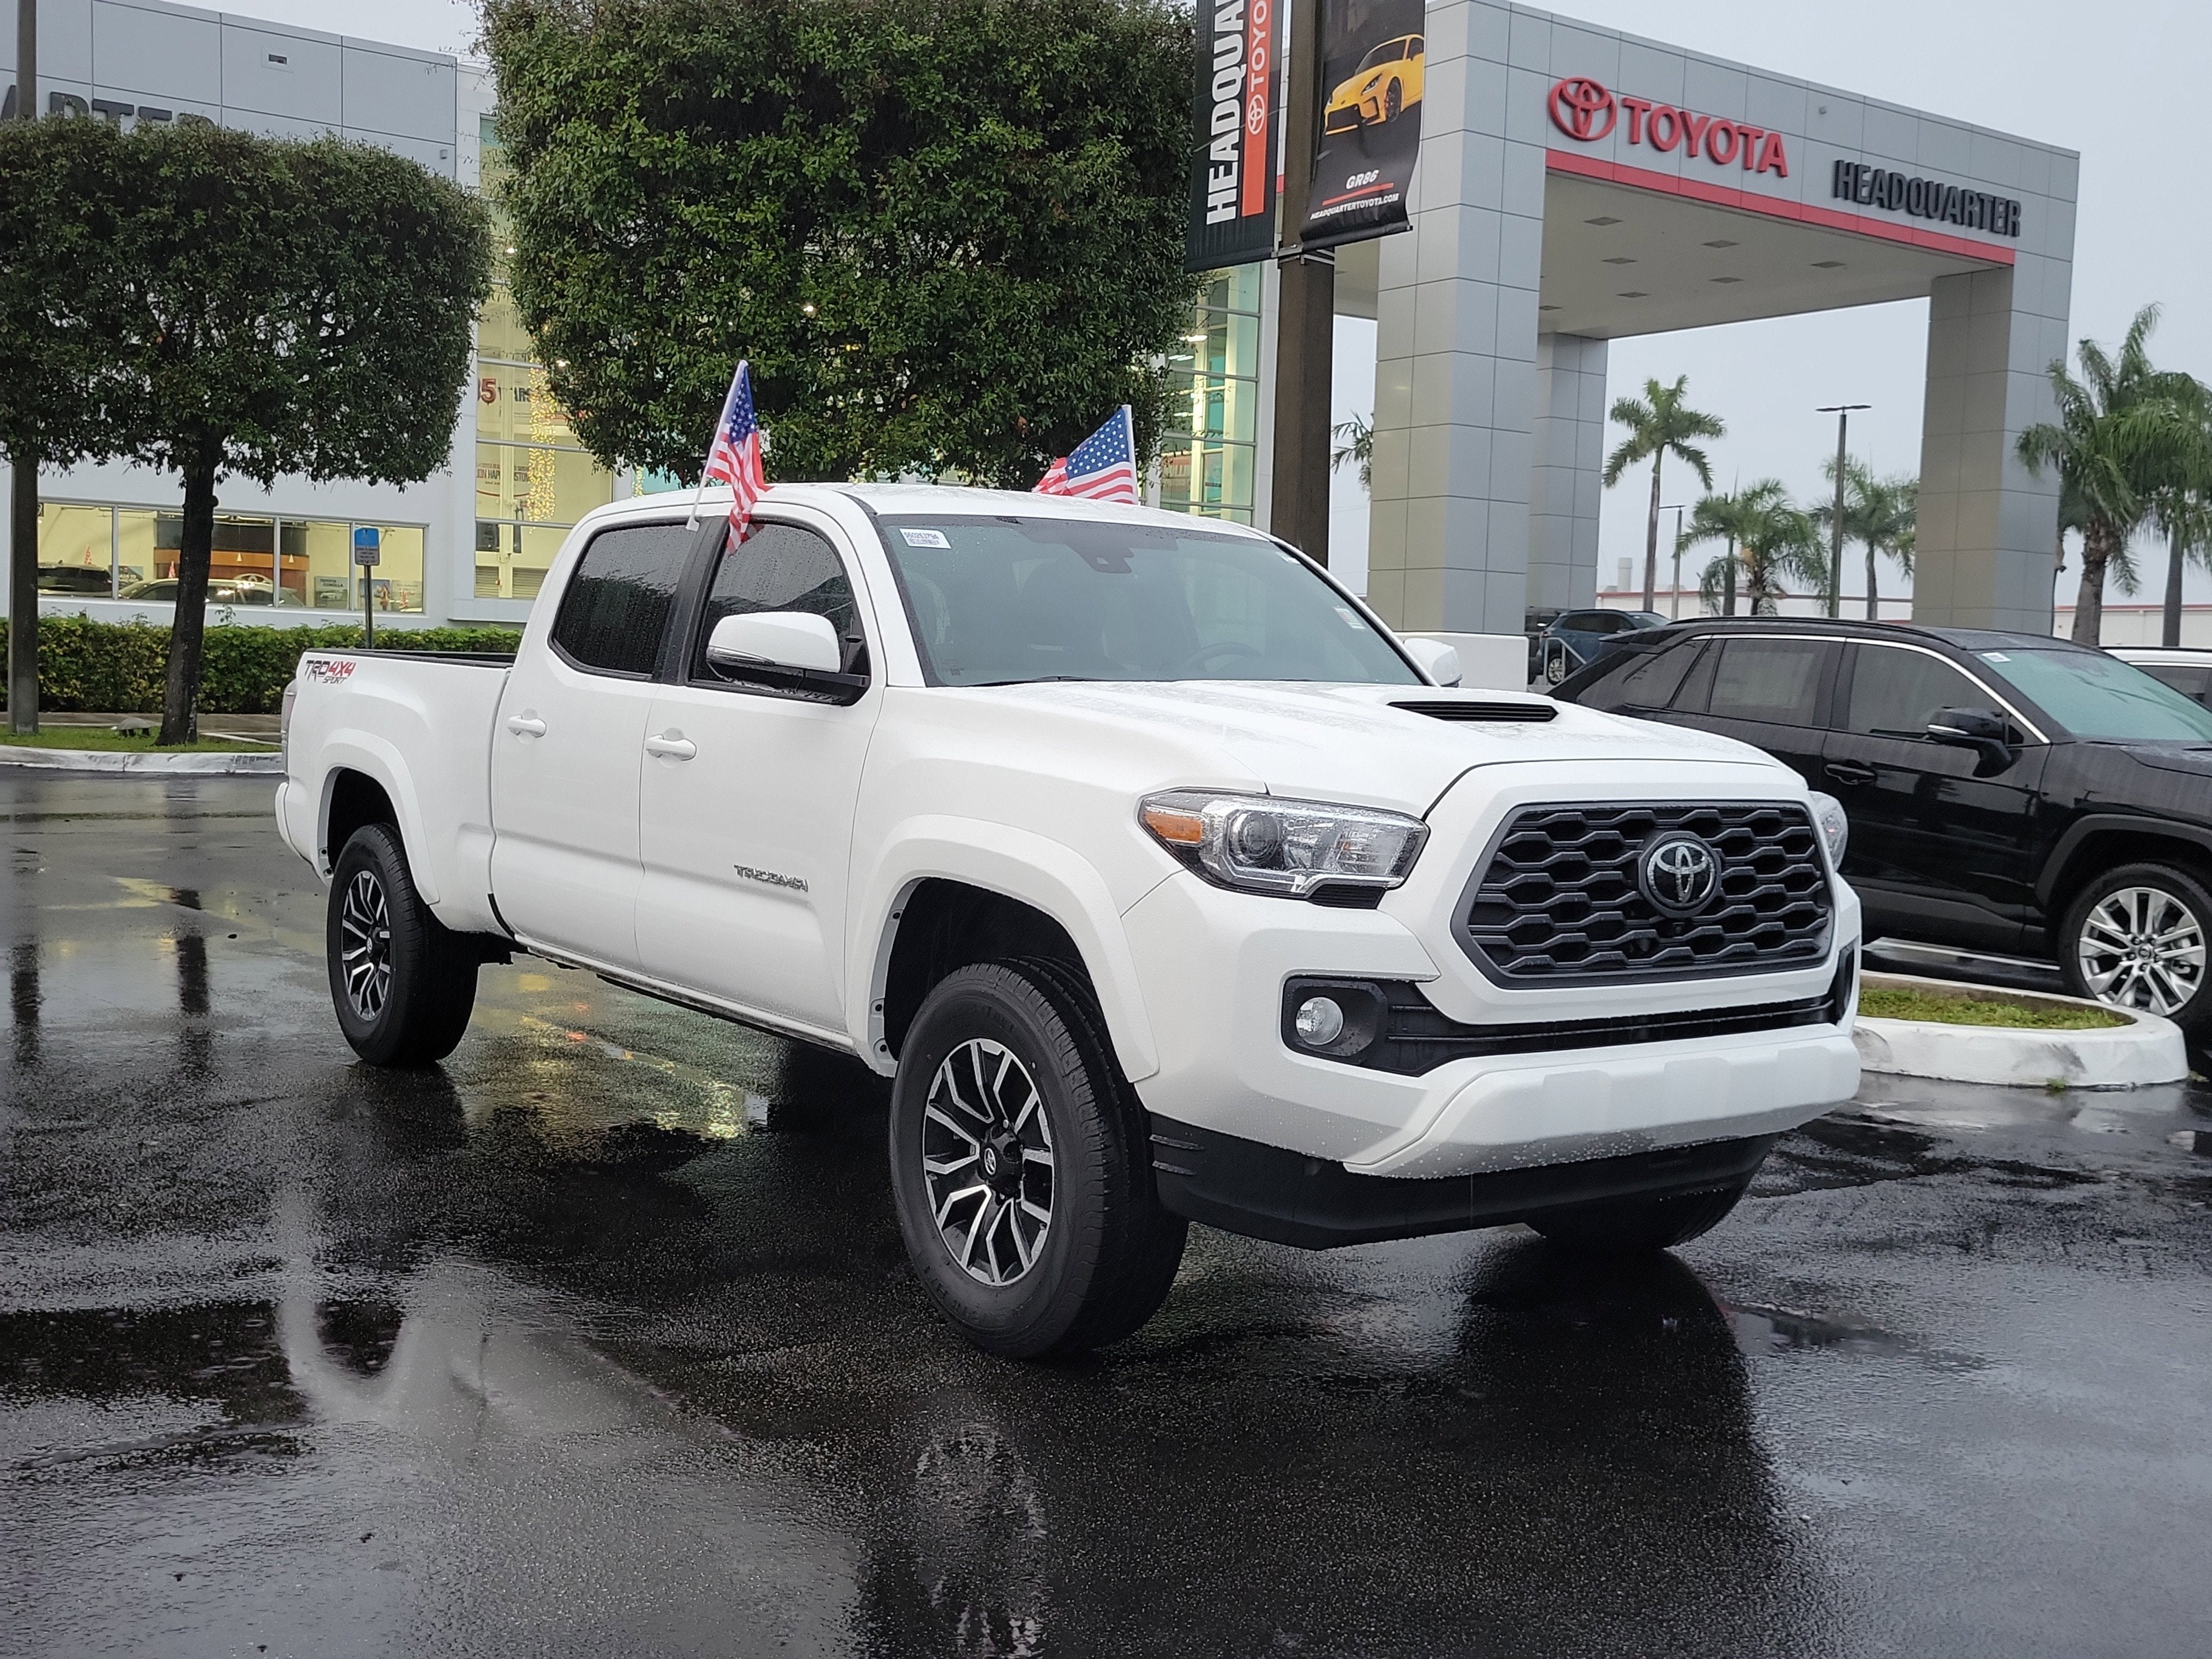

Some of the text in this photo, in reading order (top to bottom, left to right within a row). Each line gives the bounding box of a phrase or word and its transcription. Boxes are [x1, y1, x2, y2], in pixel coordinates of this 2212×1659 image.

[1250, 0, 1267, 92] TOYO
[1206, 0, 1247, 225] HEADQUA
[1622, 97, 1788, 178] TOYOTA
[1346, 169, 1380, 190] GR86
[1832, 159, 2022, 238] HEADQUARTER
[304, 660, 331, 682] TRD
